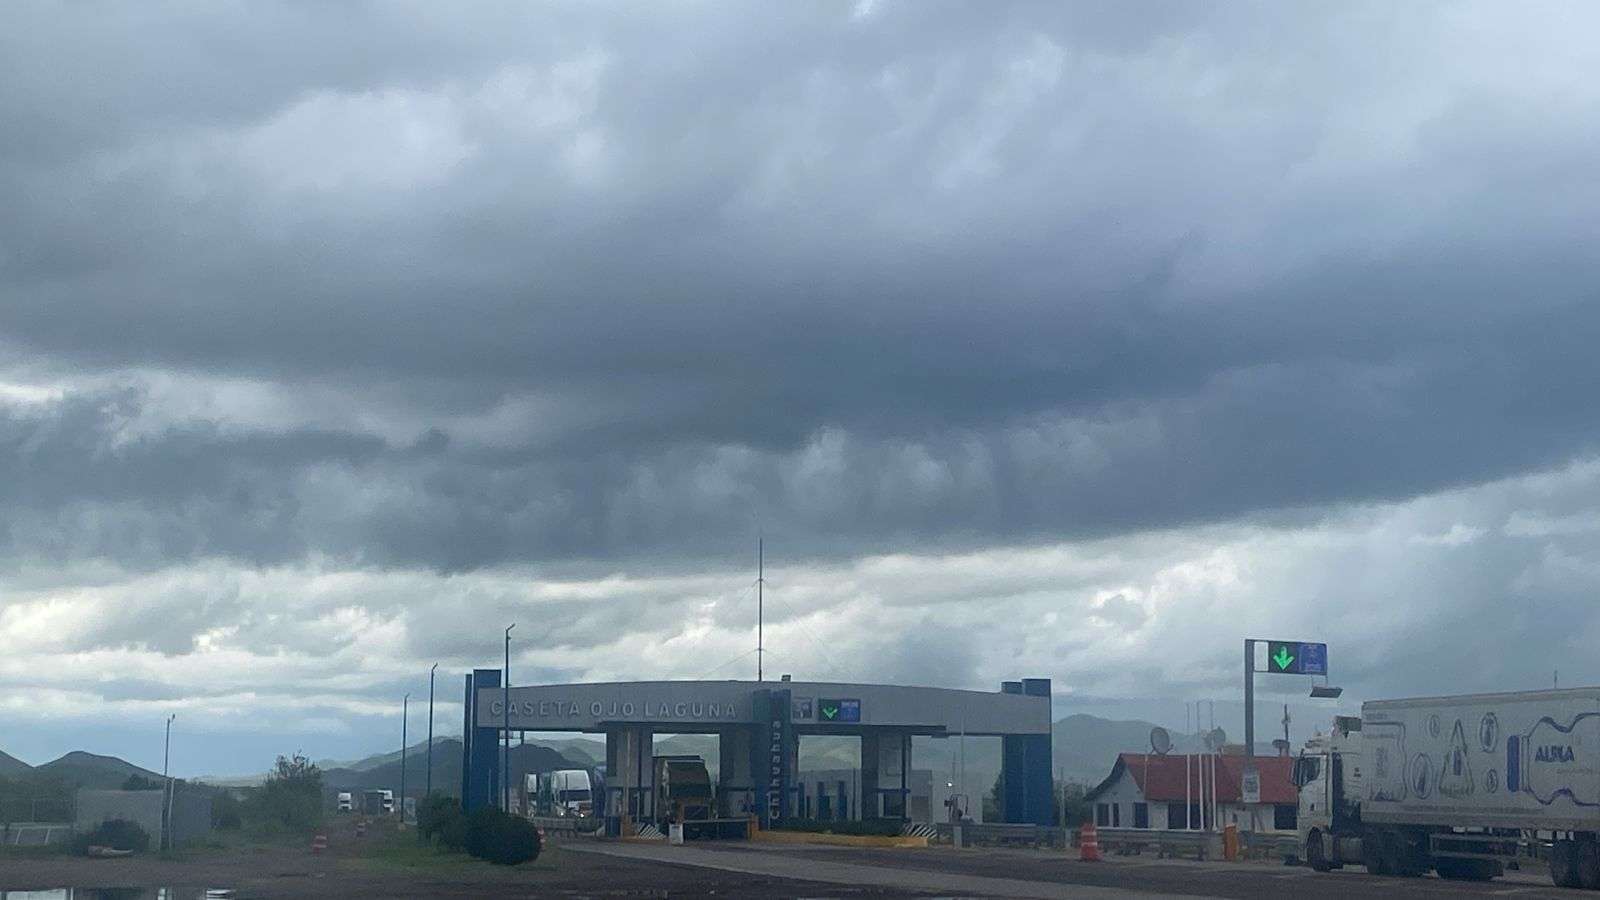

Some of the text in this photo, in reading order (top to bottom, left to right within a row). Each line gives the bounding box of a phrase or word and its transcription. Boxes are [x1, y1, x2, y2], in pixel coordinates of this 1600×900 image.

[490, 701, 737, 718] CASETA OJO LAGUNA
[770, 720, 781, 820] Chihuahua
